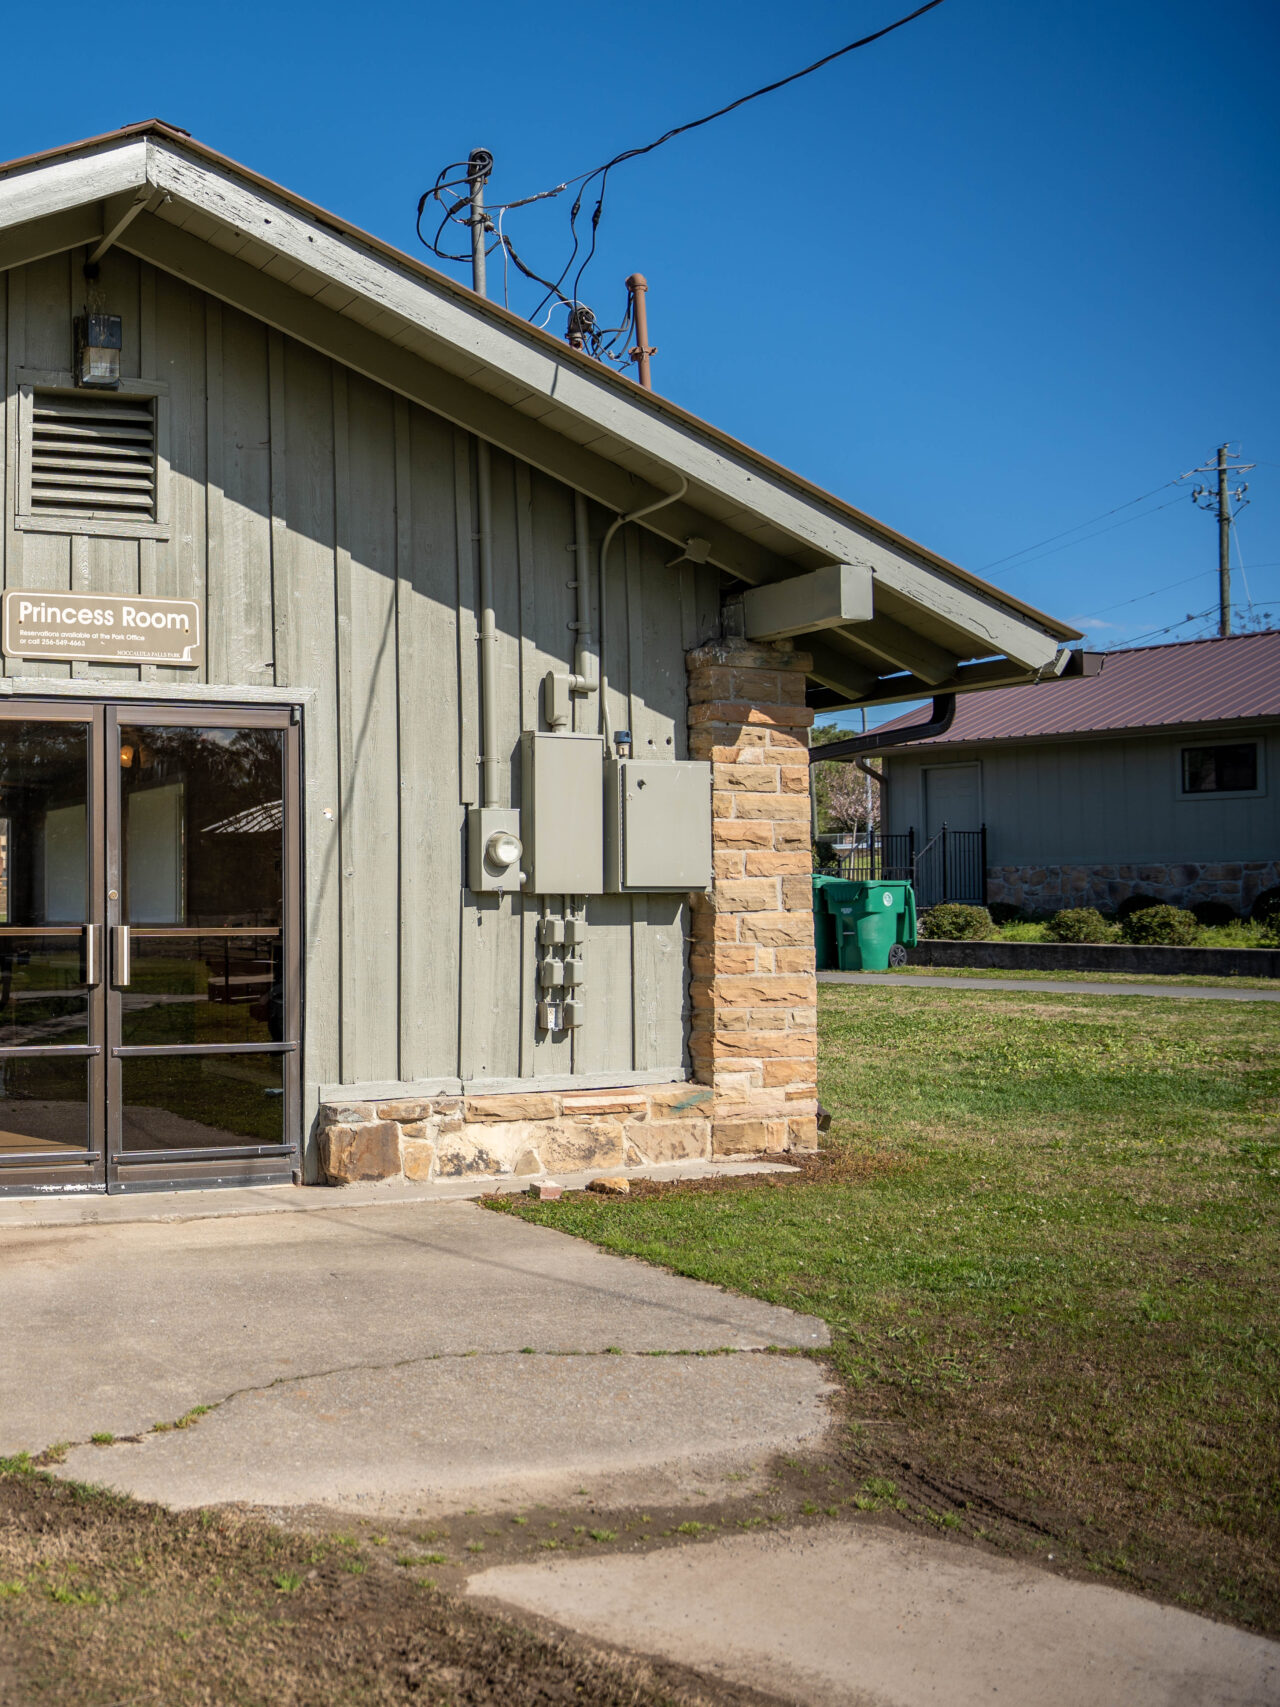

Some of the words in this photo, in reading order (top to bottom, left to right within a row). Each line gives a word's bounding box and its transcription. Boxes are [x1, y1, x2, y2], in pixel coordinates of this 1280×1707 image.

[19, 601, 114, 626] Princess
[122, 606, 189, 629] Room
[19, 629, 60, 637] Reservations
[60, 631, 91, 639] available
[99, 632, 110, 640] the
